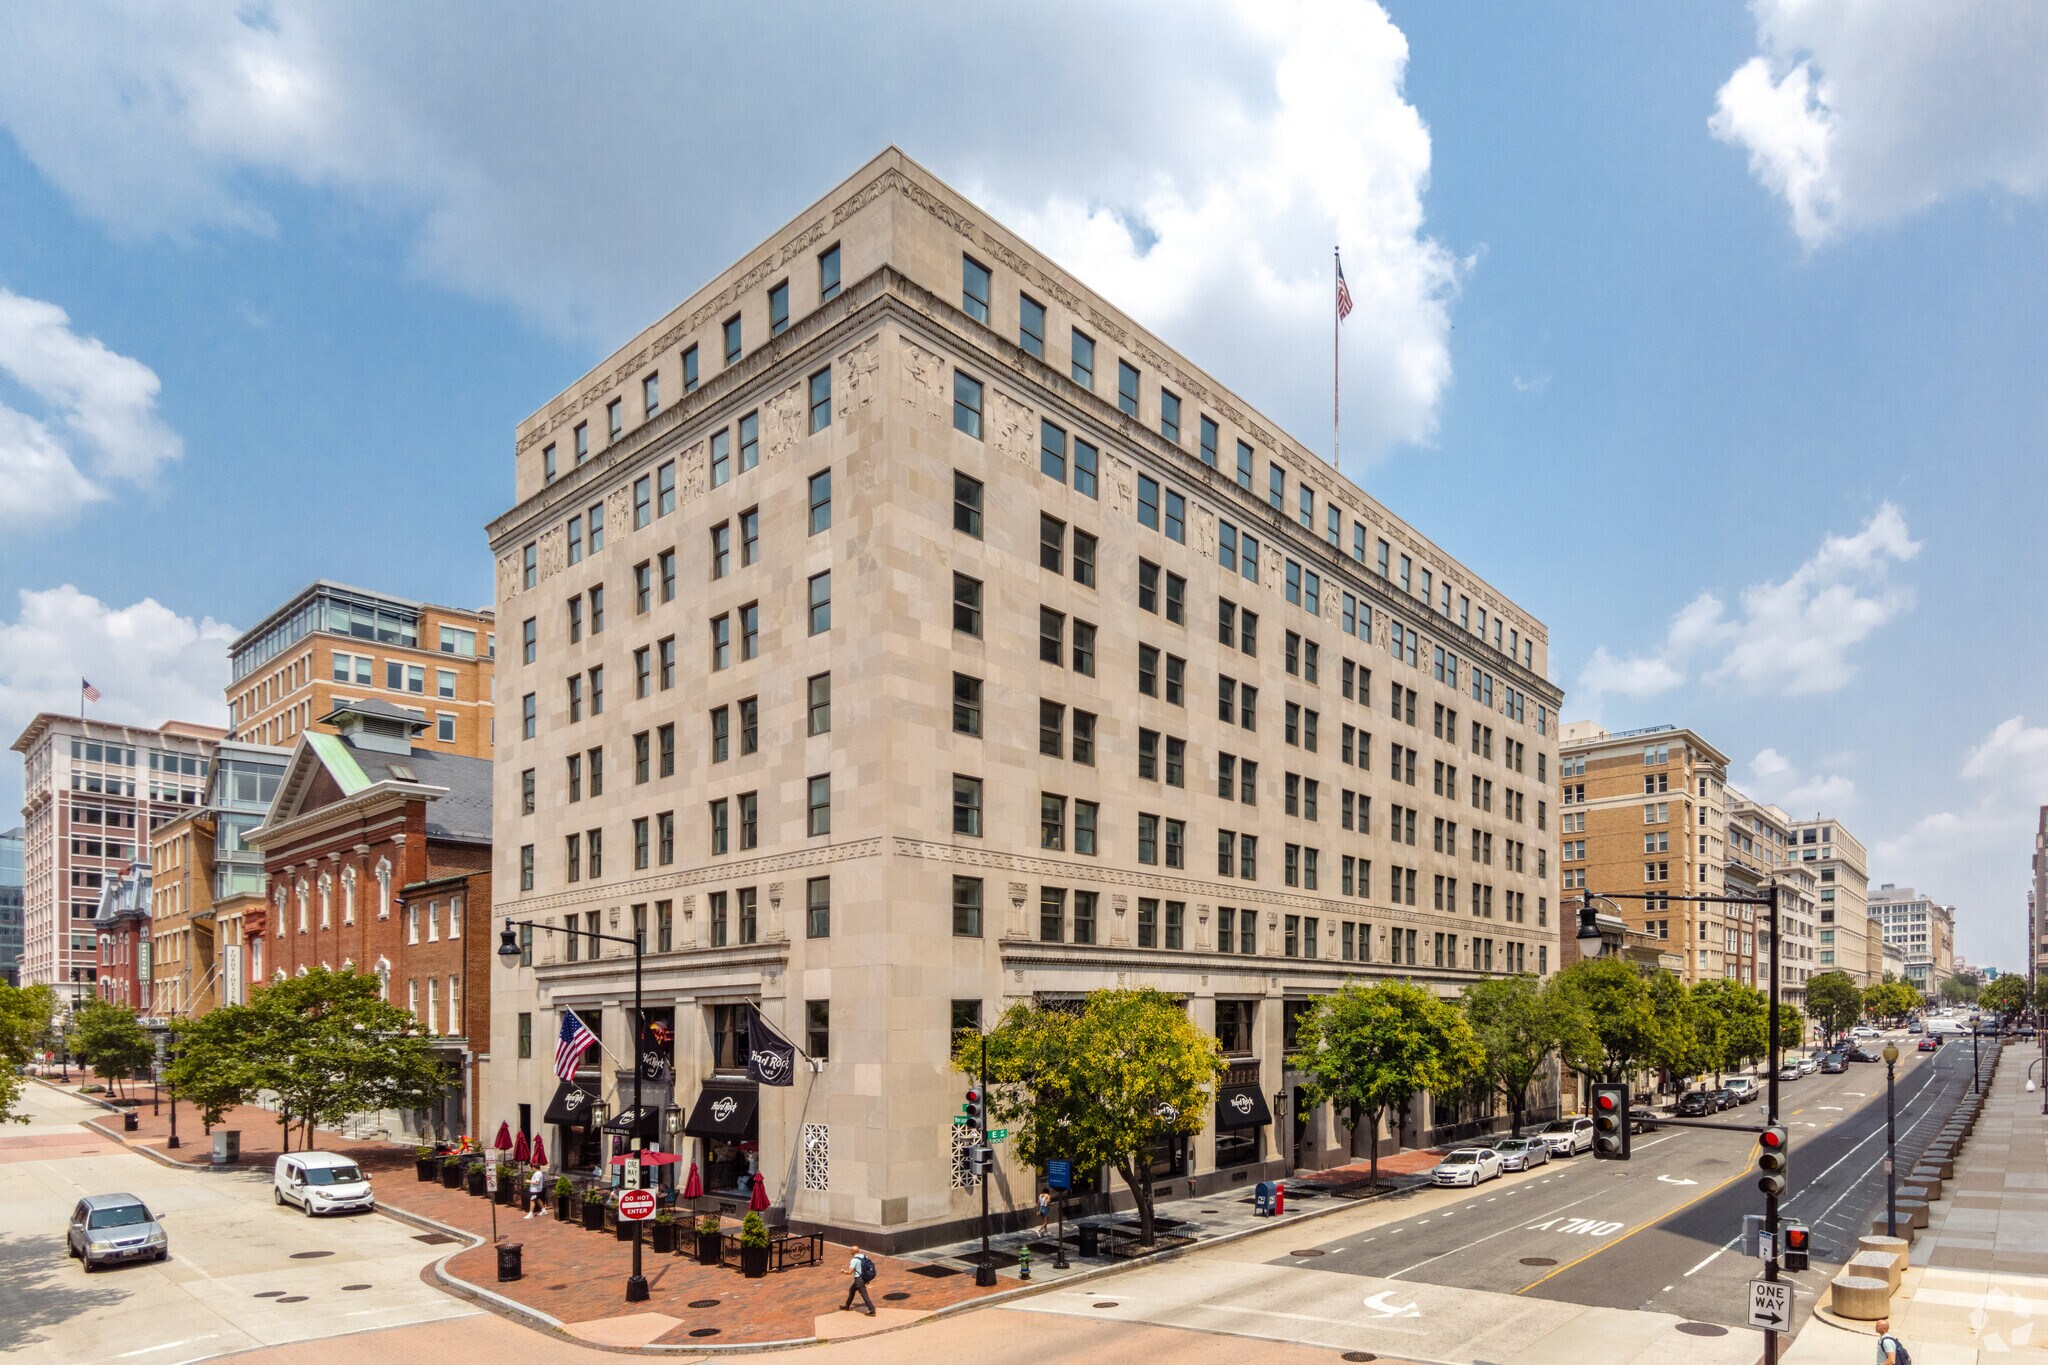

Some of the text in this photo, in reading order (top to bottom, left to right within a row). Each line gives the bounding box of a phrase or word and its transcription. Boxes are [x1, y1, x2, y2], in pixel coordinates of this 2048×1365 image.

[627, 1160, 637, 1168] ONE
[627, 1169, 637, 1177] WAY
[627, 1207, 648, 1215] ENTER
[1526, 1217, 1624, 1236] ONLY
[1756, 1284, 1784, 1299] ONE
[1755, 1296, 1785, 1311] WAY
